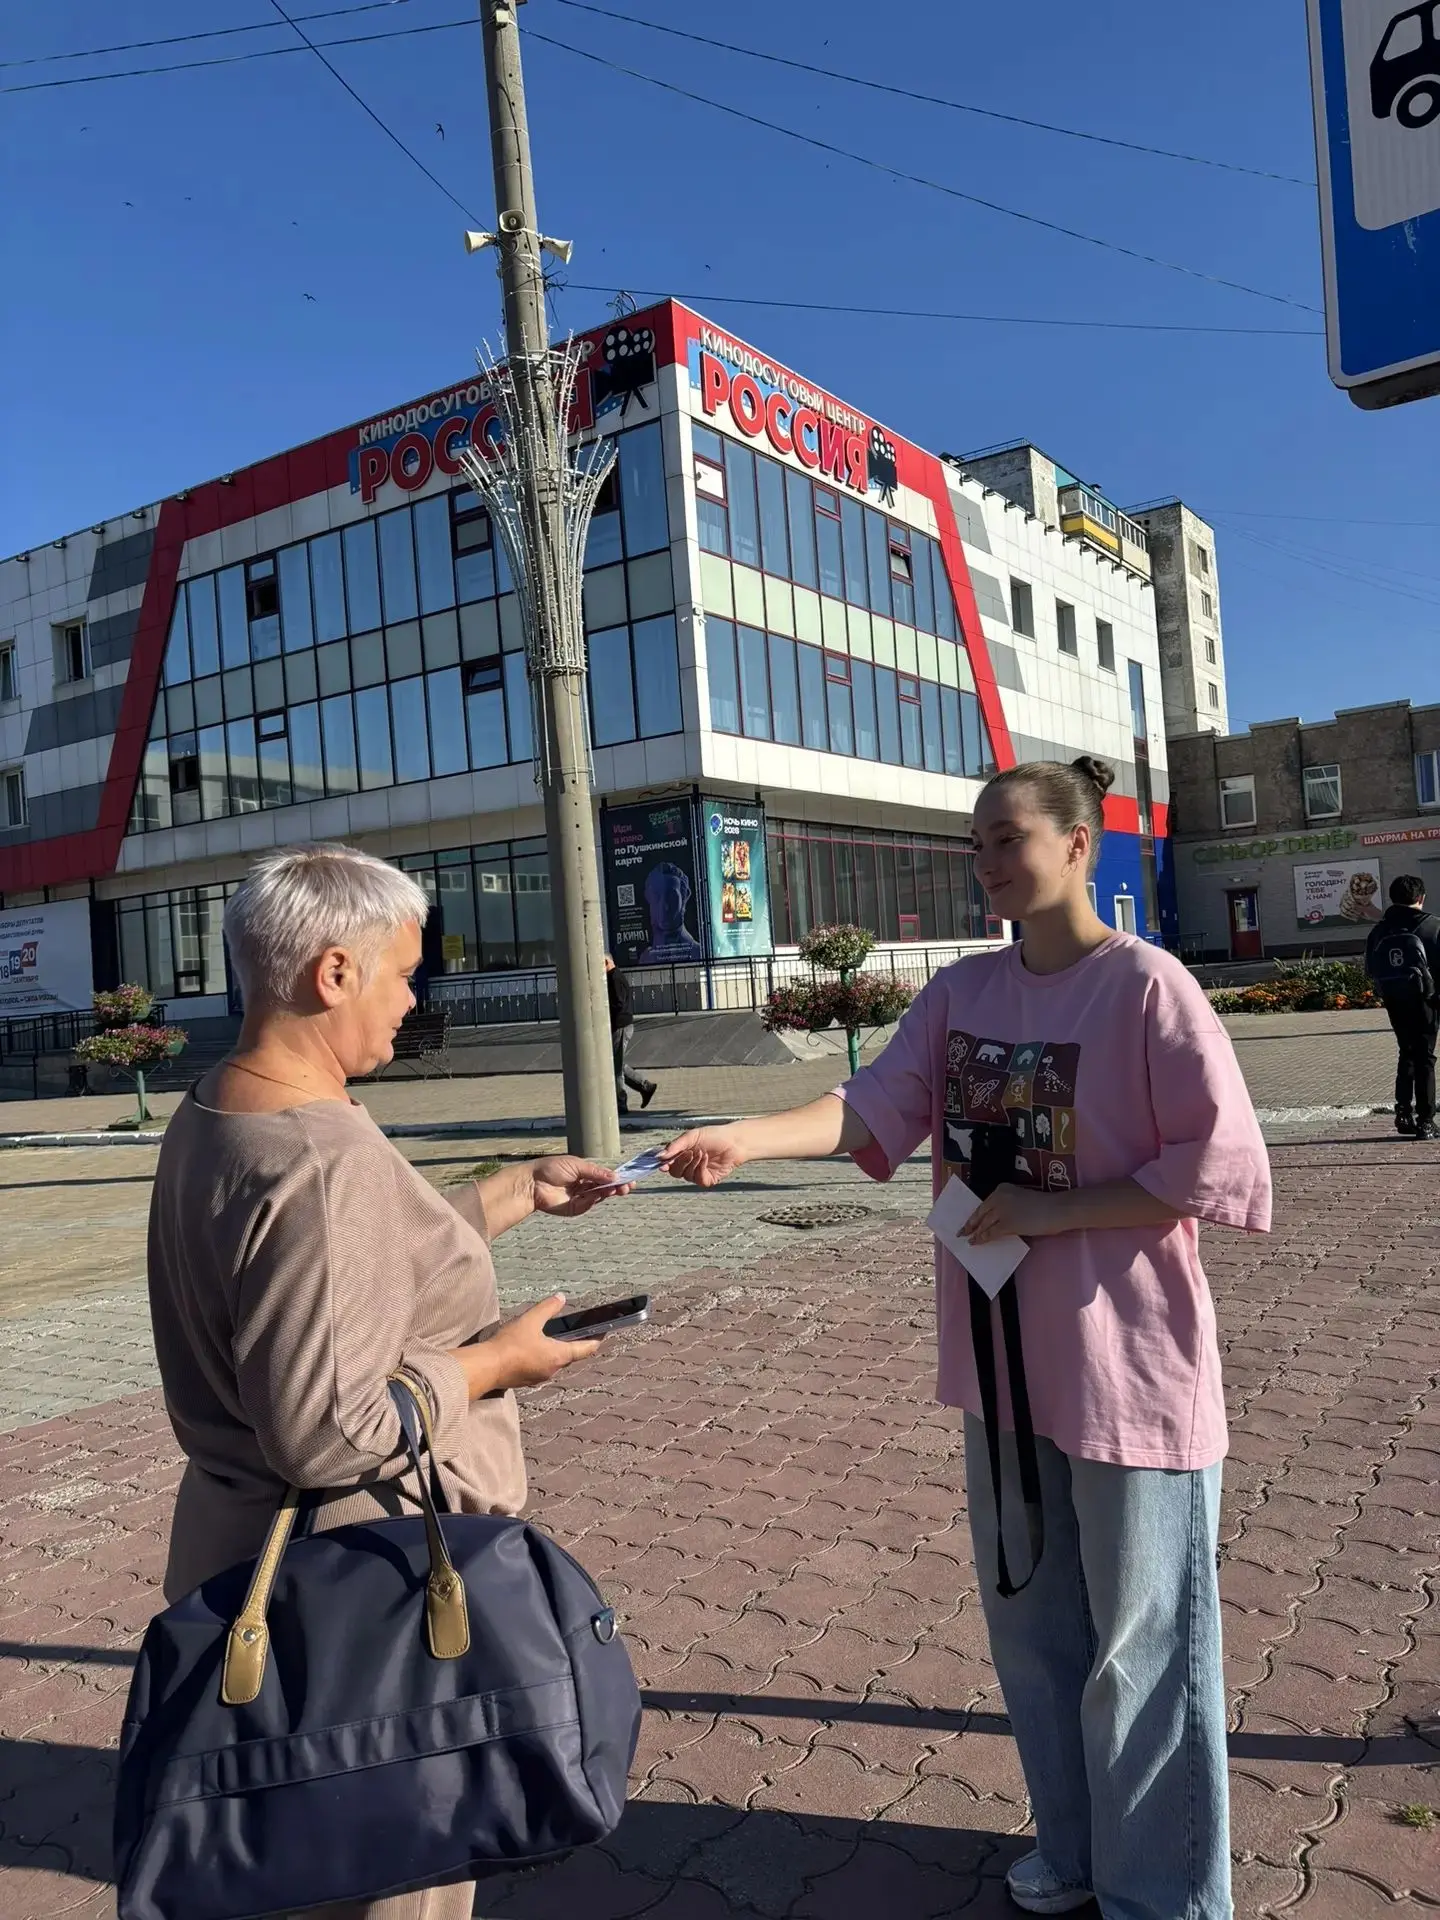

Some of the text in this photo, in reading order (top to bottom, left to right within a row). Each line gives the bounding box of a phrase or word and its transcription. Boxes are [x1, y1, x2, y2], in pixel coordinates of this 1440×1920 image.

[702, 326, 867, 435] КИНОДОСУГОВЫЙ ЦЕНТР
[701, 350, 869, 494] РОССИЯ
[1363, 832, 1409, 845] ШАУРМА
[1410, 830, 1426, 841] НА
[614, 837, 689, 857] по Пушкинской
[615, 856, 643, 868] карте
[1304, 878, 1346, 888] ГОЛОДЕН?
[22, 948, 35, 961] 20
[10, 955, 21, 970] 19
